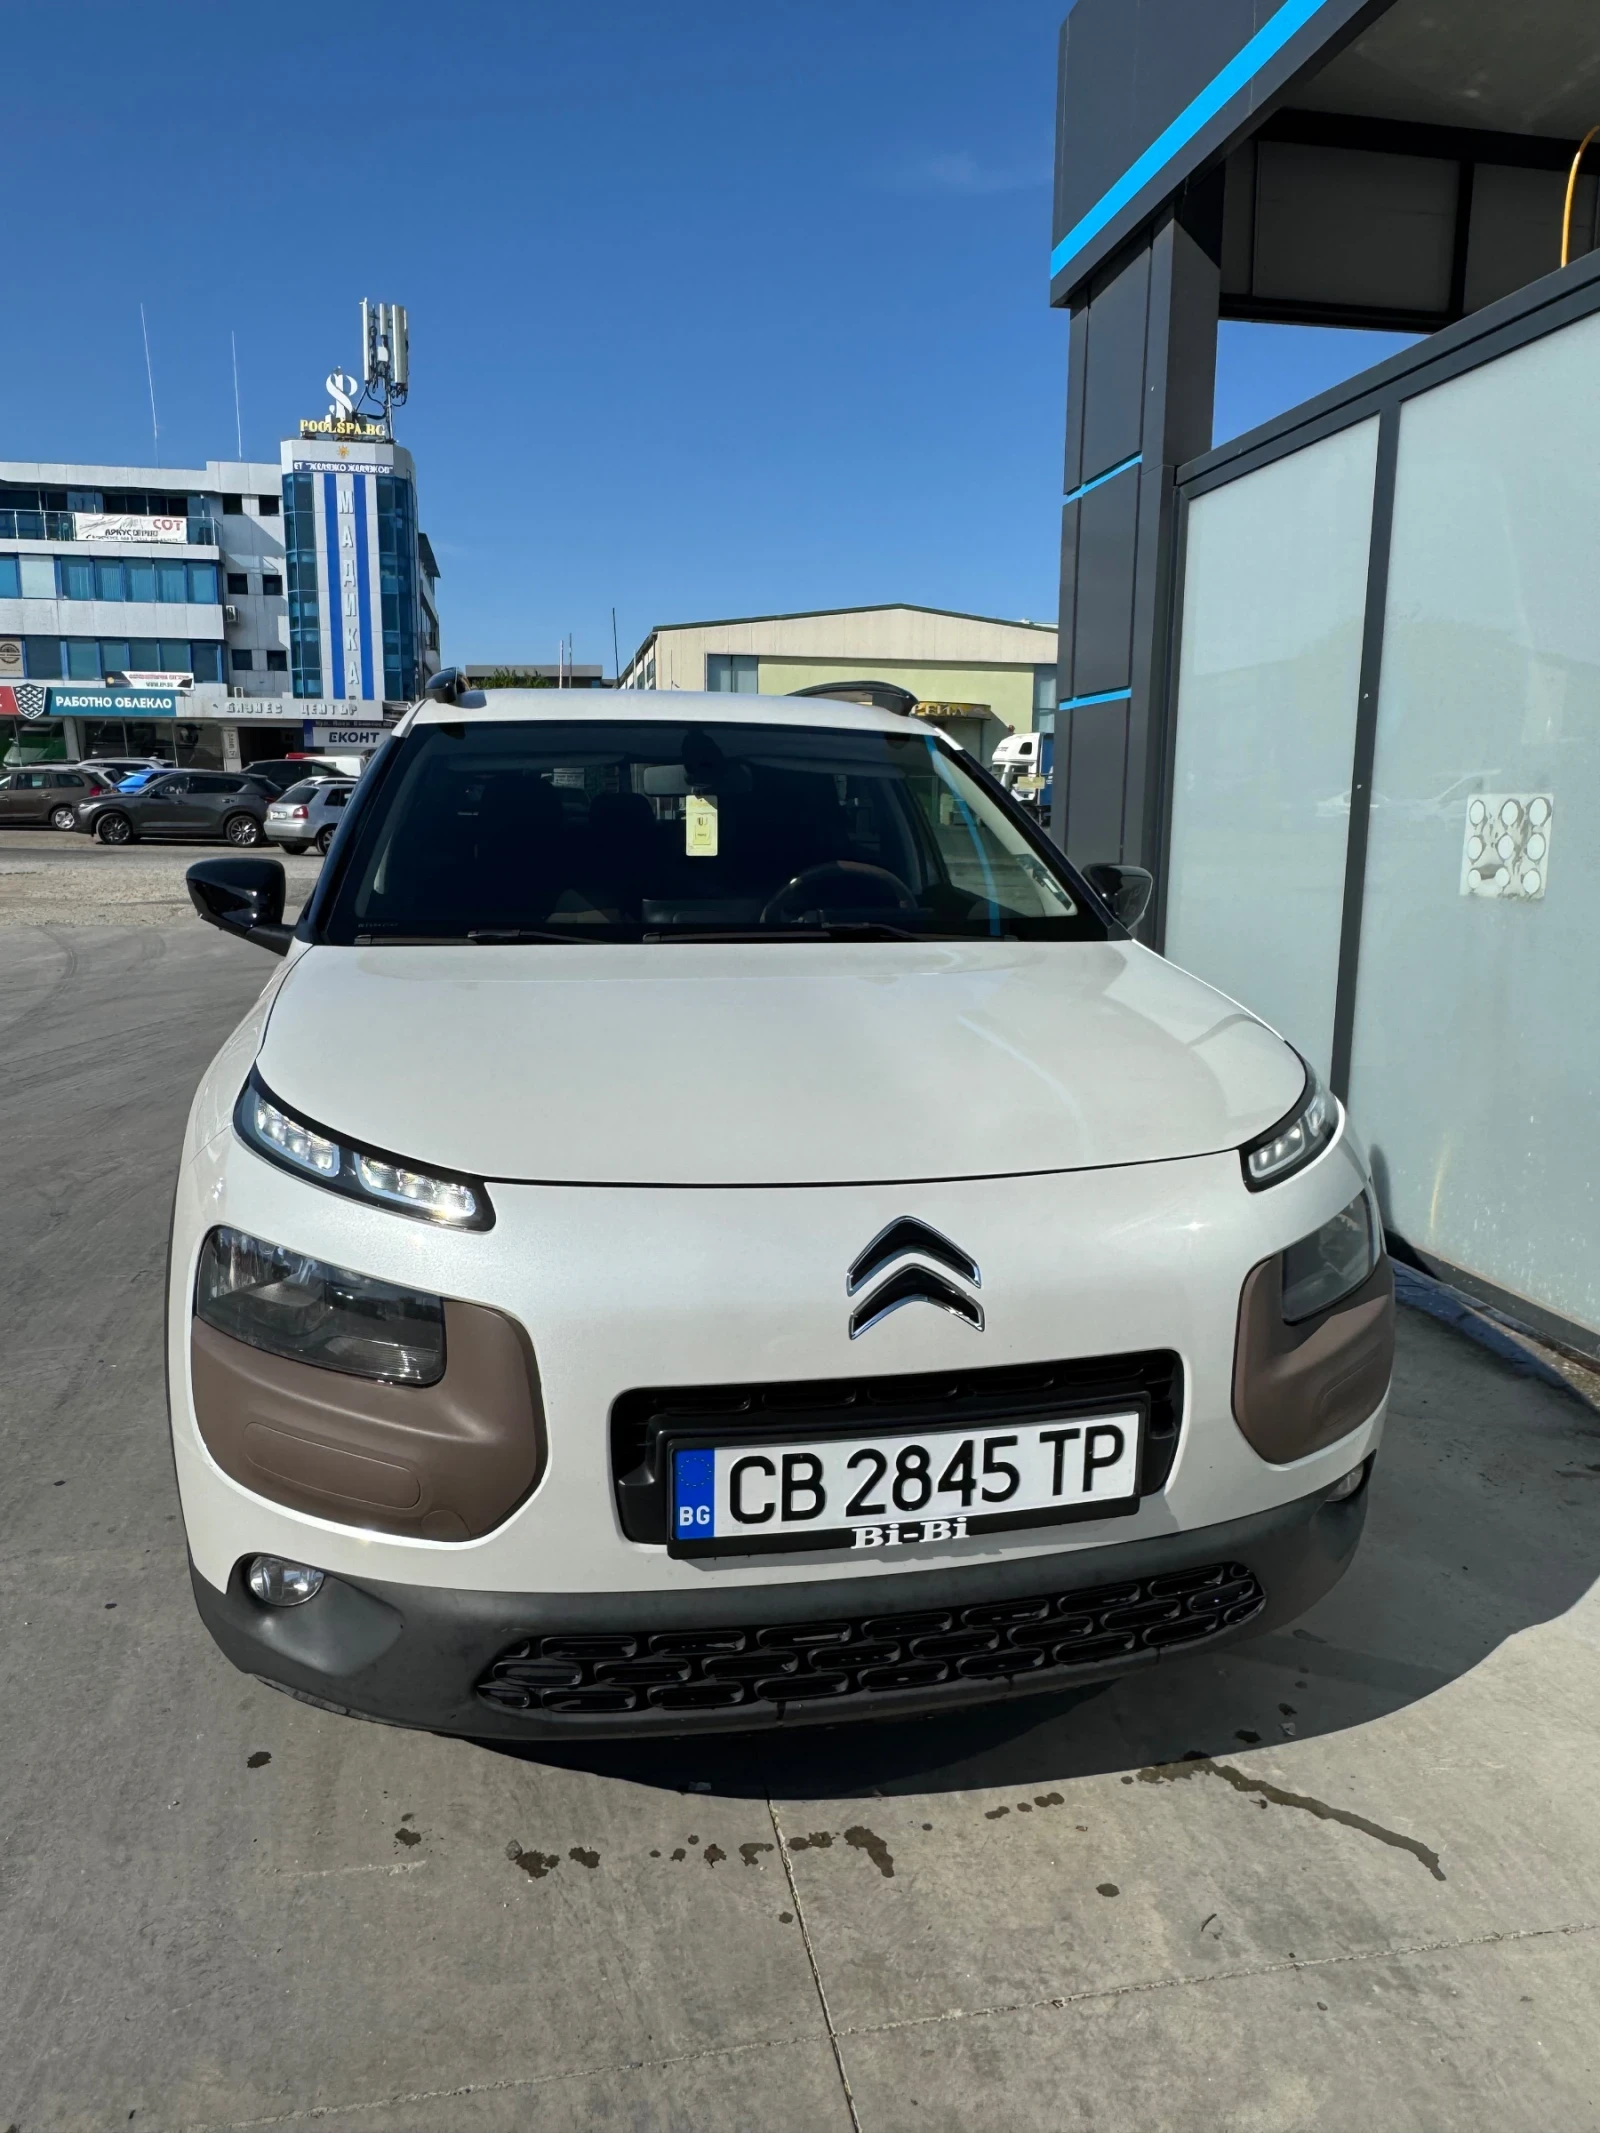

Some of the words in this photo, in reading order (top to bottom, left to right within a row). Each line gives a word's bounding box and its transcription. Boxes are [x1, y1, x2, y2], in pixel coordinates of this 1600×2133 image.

[300, 419, 386, 436] POOLSPA.BG
[55, 695, 113, 708] РАБОТНО
[115, 697, 172, 709] ОБЛЕКЛО
[328, 731, 381, 743] ЕКОНТ
[729, 1452, 828, 1524] CB
[844, 1434, 1022, 1518] 2845
[1038, 1424, 1125, 1496] TP
[678, 1504, 711, 1527] BG
[850, 1515, 970, 1550] Bi-Bi
